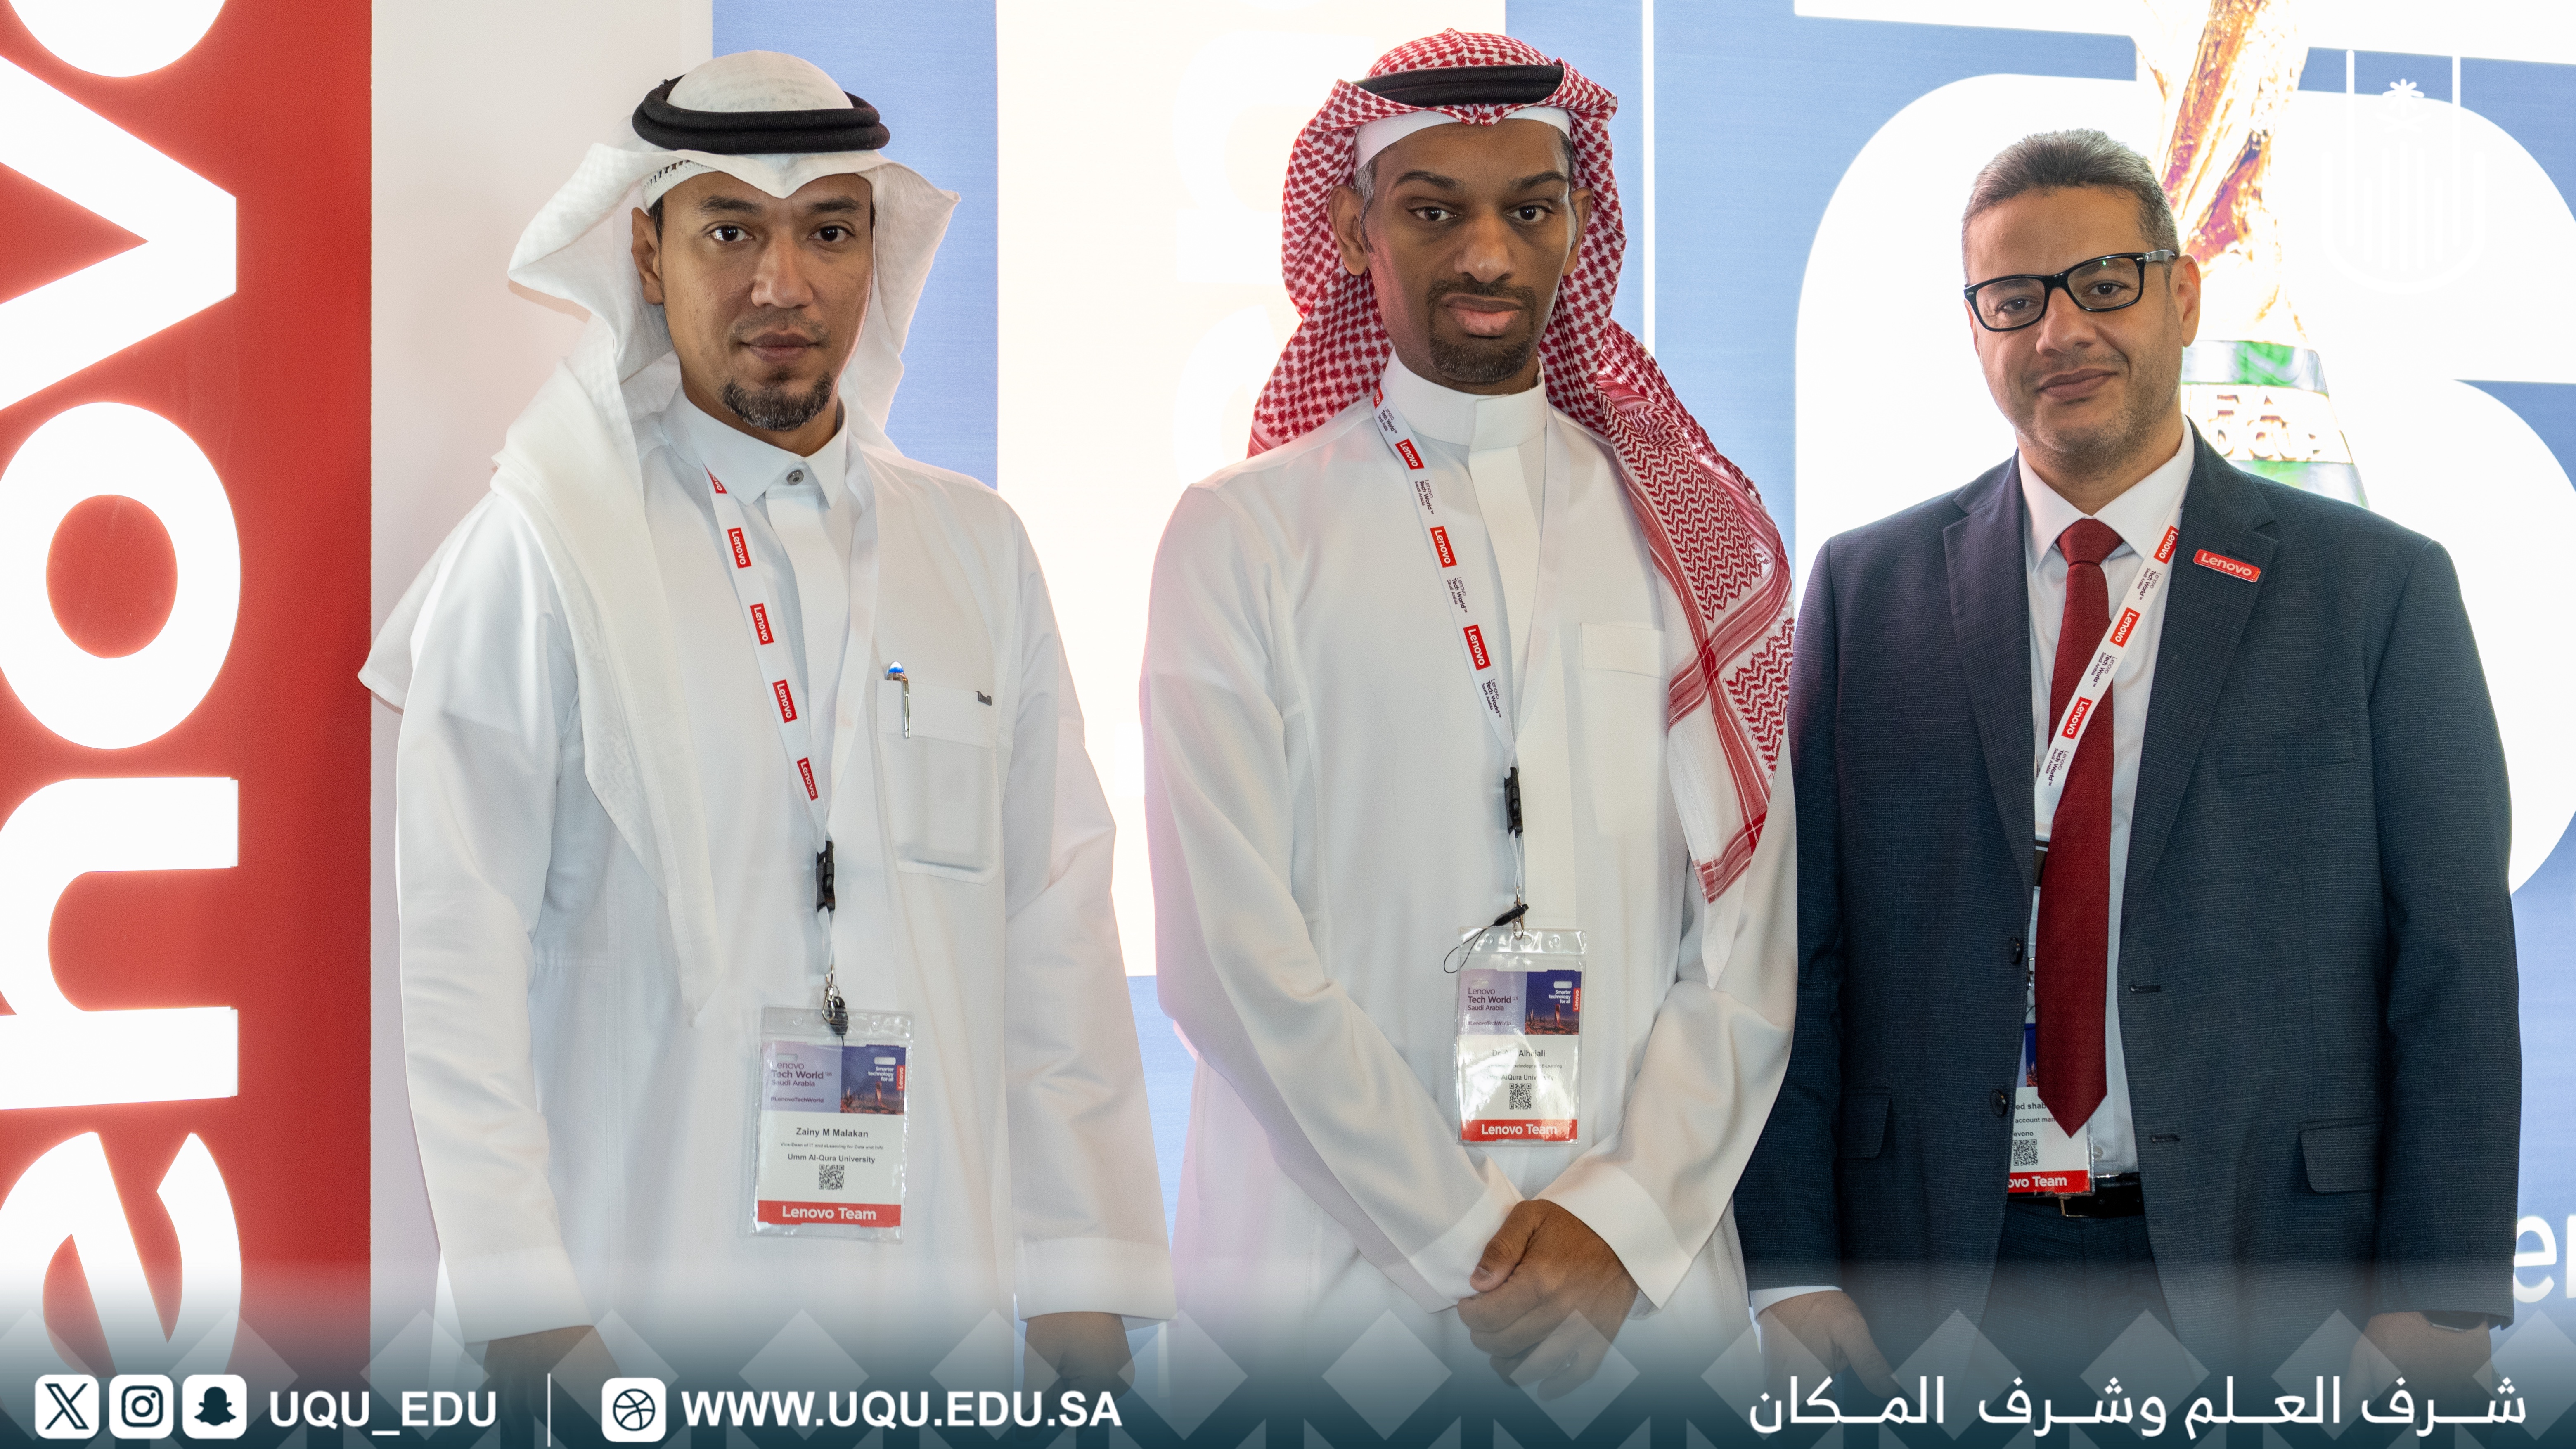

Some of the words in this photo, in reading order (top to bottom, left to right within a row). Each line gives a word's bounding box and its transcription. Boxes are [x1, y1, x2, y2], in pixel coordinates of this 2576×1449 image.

[1385, 405, 1395, 421] Lenovo
[1386, 418, 1396, 432] World
[1399, 442, 1418, 467] Lenovo
[1425, 479, 1433, 498] Lenovo
[1424, 493, 1433, 510] World
[731, 530, 746, 565] Lenovo
[1434, 530, 1451, 564] Lenovo
[2159, 530, 2179, 559] Lenovo
[2201, 552, 2252, 576] Lenovo
[2137, 577, 2145, 590] Arabia
[2147, 570, 2157, 581] Tech
[2150, 572, 2162, 589] Lenovo
[1457, 577, 1467, 597] Lenovo
[2139, 582, 2151, 598] World
[1456, 591, 1466, 609] World
[754, 606, 769, 642] Lenovo
[2114, 612, 2137, 643] Lenovo
[1468, 628, 1485, 666] Lenovo
[2098, 651, 2107, 663] Saudi
[2102, 655, 2112, 666] Tech
[2104, 656, 2118, 675] Lenovo
[2091, 663, 2101, 676] Arabia
[2093, 666, 2106, 683] World
[1491, 678, 1500, 699] Lenovo
[777, 683, 792, 719] Lenovo
[1491, 695, 1500, 714] World
[2067, 701, 2089, 735] Lenovo
[2050, 748, 2059, 760] Saudi
[2055, 750, 2065, 762] Tech
[2057, 751, 2069, 771] Lenovo
[2045, 760, 2053, 774] Arabia
[2048, 763, 2059, 782] World
[800, 761, 815, 797] Lenovo
[1468, 987, 1496, 995] Lenovo
[1488, 995, 1512, 1004] World
[796, 1070, 824, 1079] World
[796, 1127, 819, 1137] Zainy
[833, 1129, 869, 1138] Malakan
[1481, 1124, 1523, 1135] Lenovo
[1526, 1124, 1558, 1134] Team
[2031, 1175, 2068, 1187] Team
[782, 1205, 834, 1220] Lenovo
[838, 1207, 877, 1221] Team
